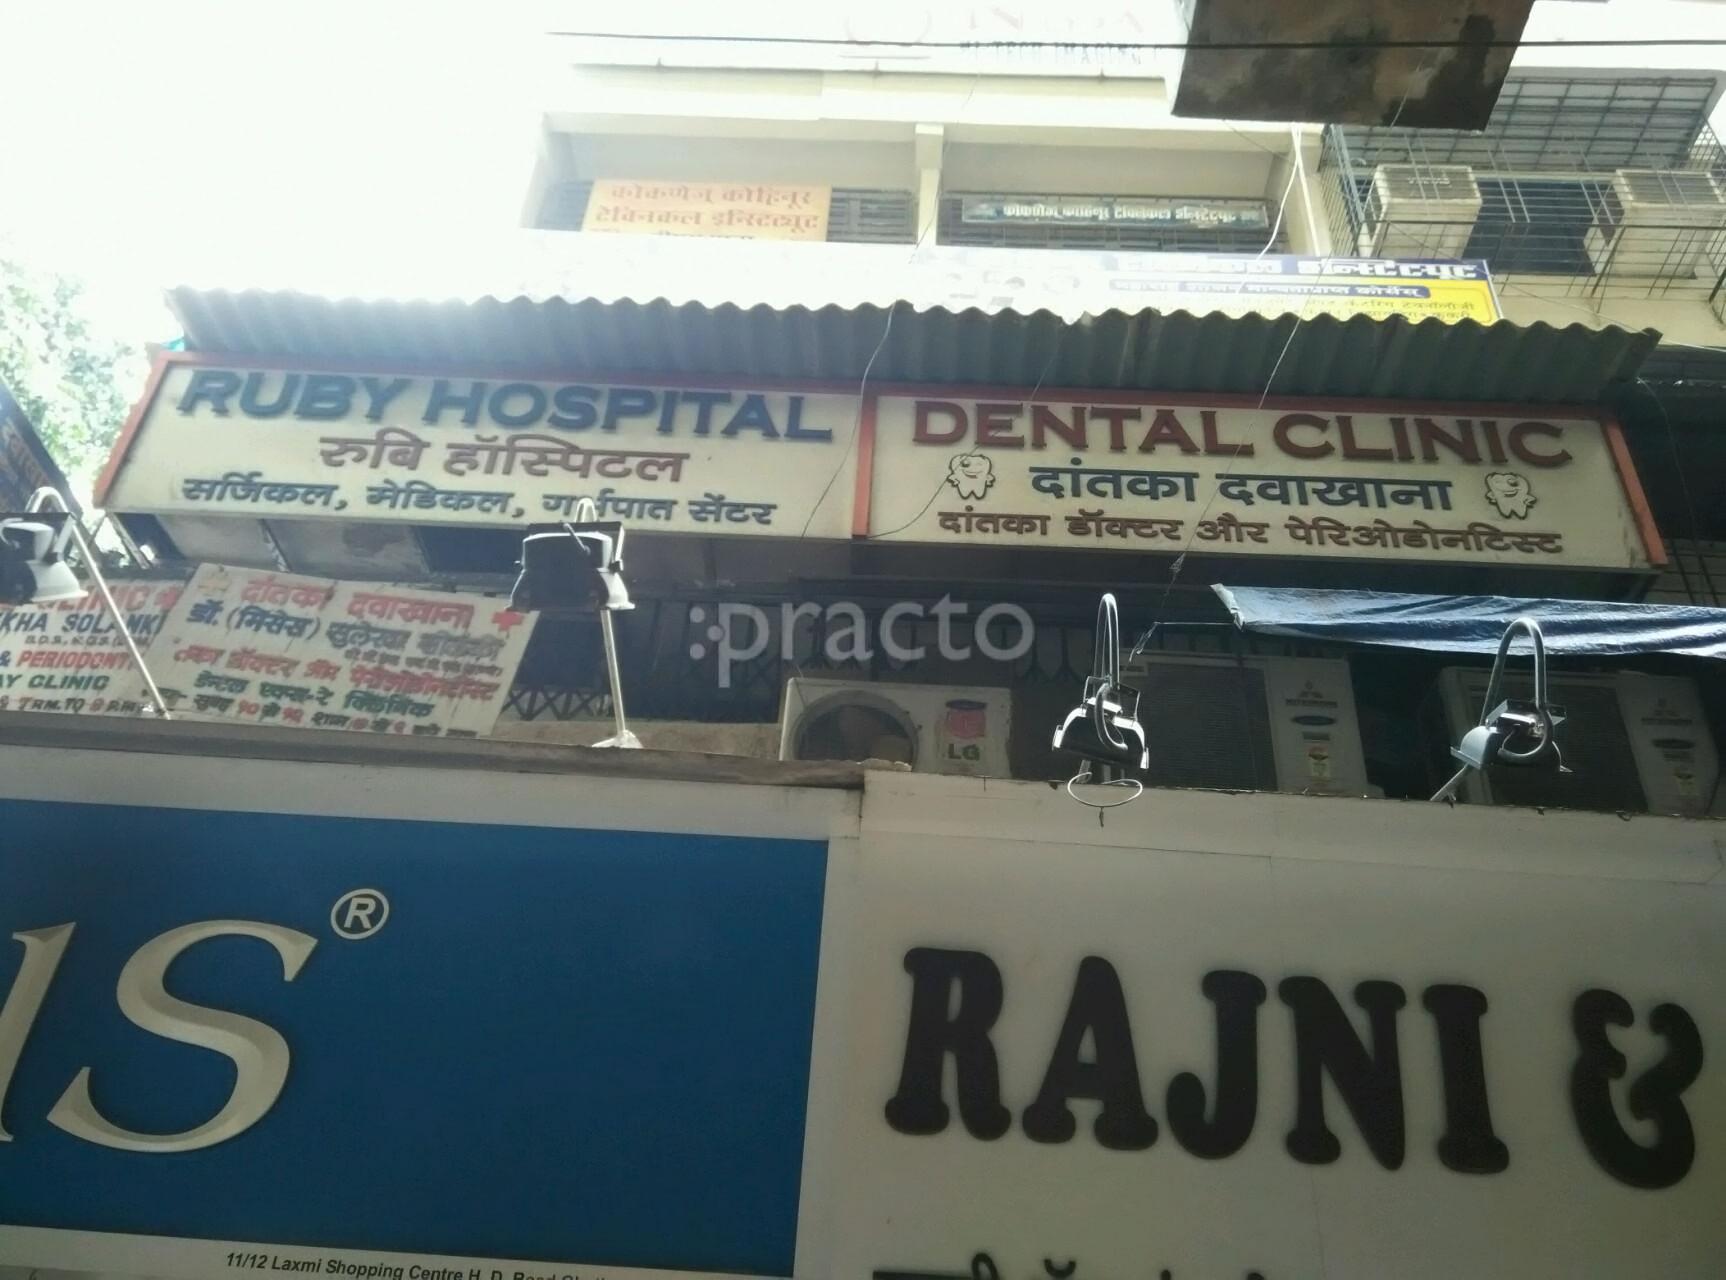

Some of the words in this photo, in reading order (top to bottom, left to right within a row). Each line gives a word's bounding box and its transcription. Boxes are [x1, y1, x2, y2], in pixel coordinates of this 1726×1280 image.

[177, 369, 411, 422] RUBY
[421, 378, 833, 442] HOSPITAL
[912, 401, 1255, 456] DENTAL
[1273, 413, 1573, 468] CLINIC
[443, 433, 690, 482] हॉस्पिटल
[1028, 457, 1200, 502] दांतका
[1215, 472, 1453, 511] दवाखाना
[937, 505, 1051, 536] दांतका
[1064, 508, 1184, 541] डॉक्टर
[1196, 512, 1270, 544] और
[0, 612, 48, 634] KHA
[28, 674, 110, 691] CLINIC
[948, 743, 980, 761] LG
[884, 946, 1510, 1175] RAJNI
[1571, 988, 1704, 1190] &
[226, 1252, 268, 1270] 11/12
[272, 1255, 321, 1274] Laxmi
[326, 1259, 404, 1280] Shopping
[409, 1265, 463, 1280] Centre
